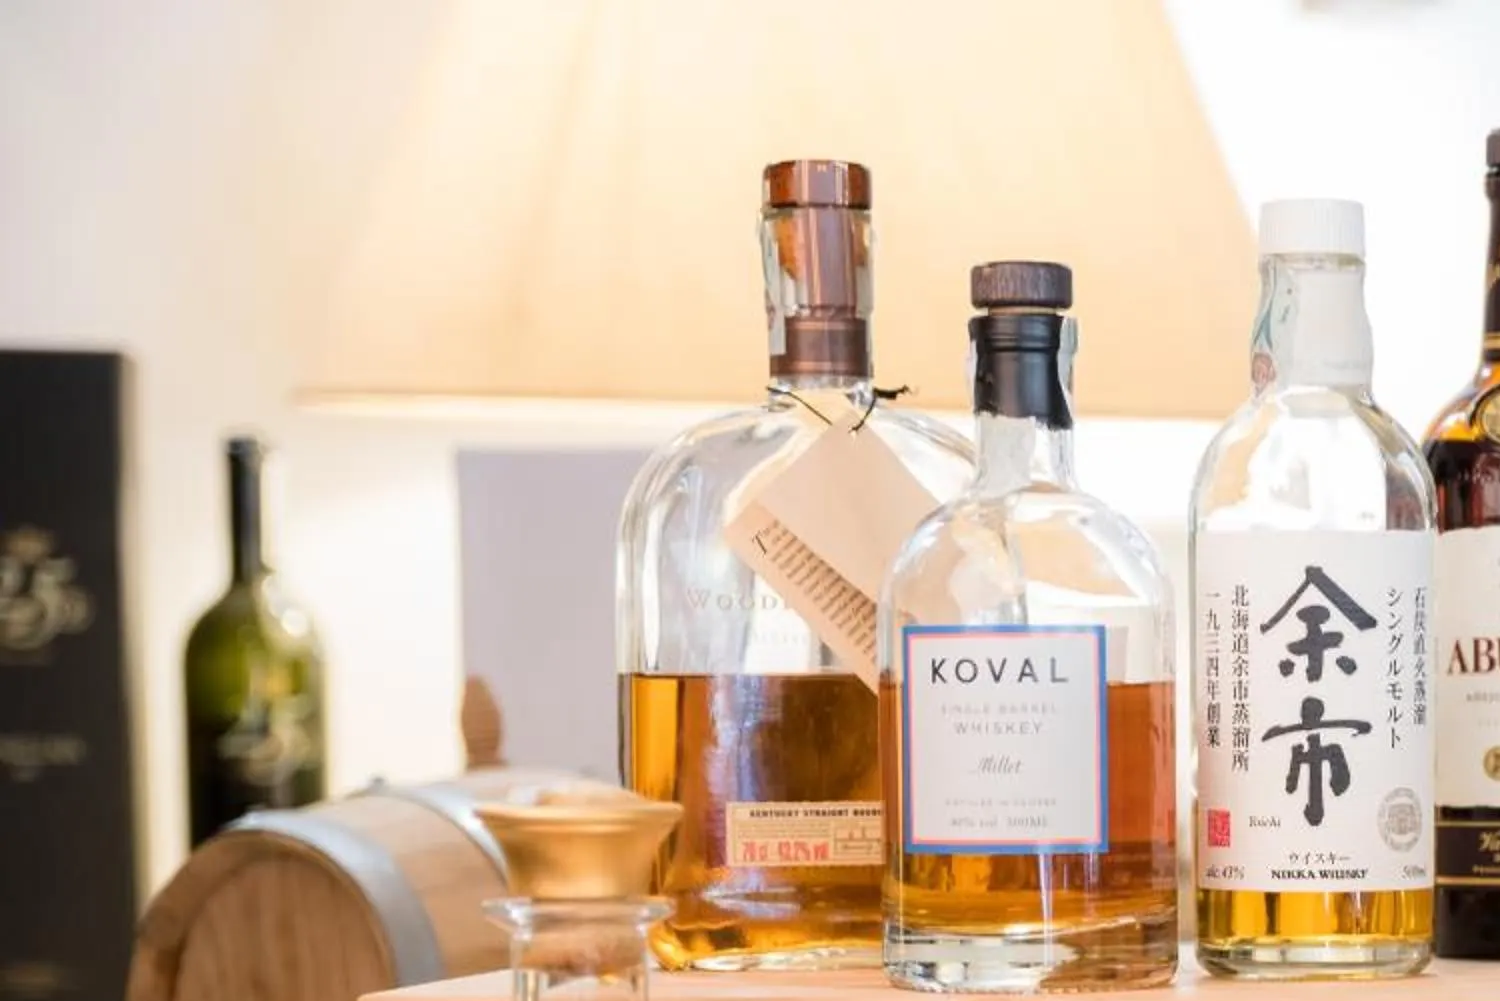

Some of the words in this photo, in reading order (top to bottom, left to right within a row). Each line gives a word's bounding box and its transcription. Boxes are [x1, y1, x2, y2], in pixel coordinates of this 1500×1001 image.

[687, 588, 789, 611] WOOD
[931, 657, 1069, 684] KOVAL
[1386, 587, 1403, 749] シングルモルト
[1260, 565, 1377, 827] 余市
[954, 721, 1044, 735] WHISKEY
[1289, 851, 1353, 865] ウイスキー
[1271, 868, 1315, 879] NIKKA
[1319, 868, 1369, 879] WHISKY
